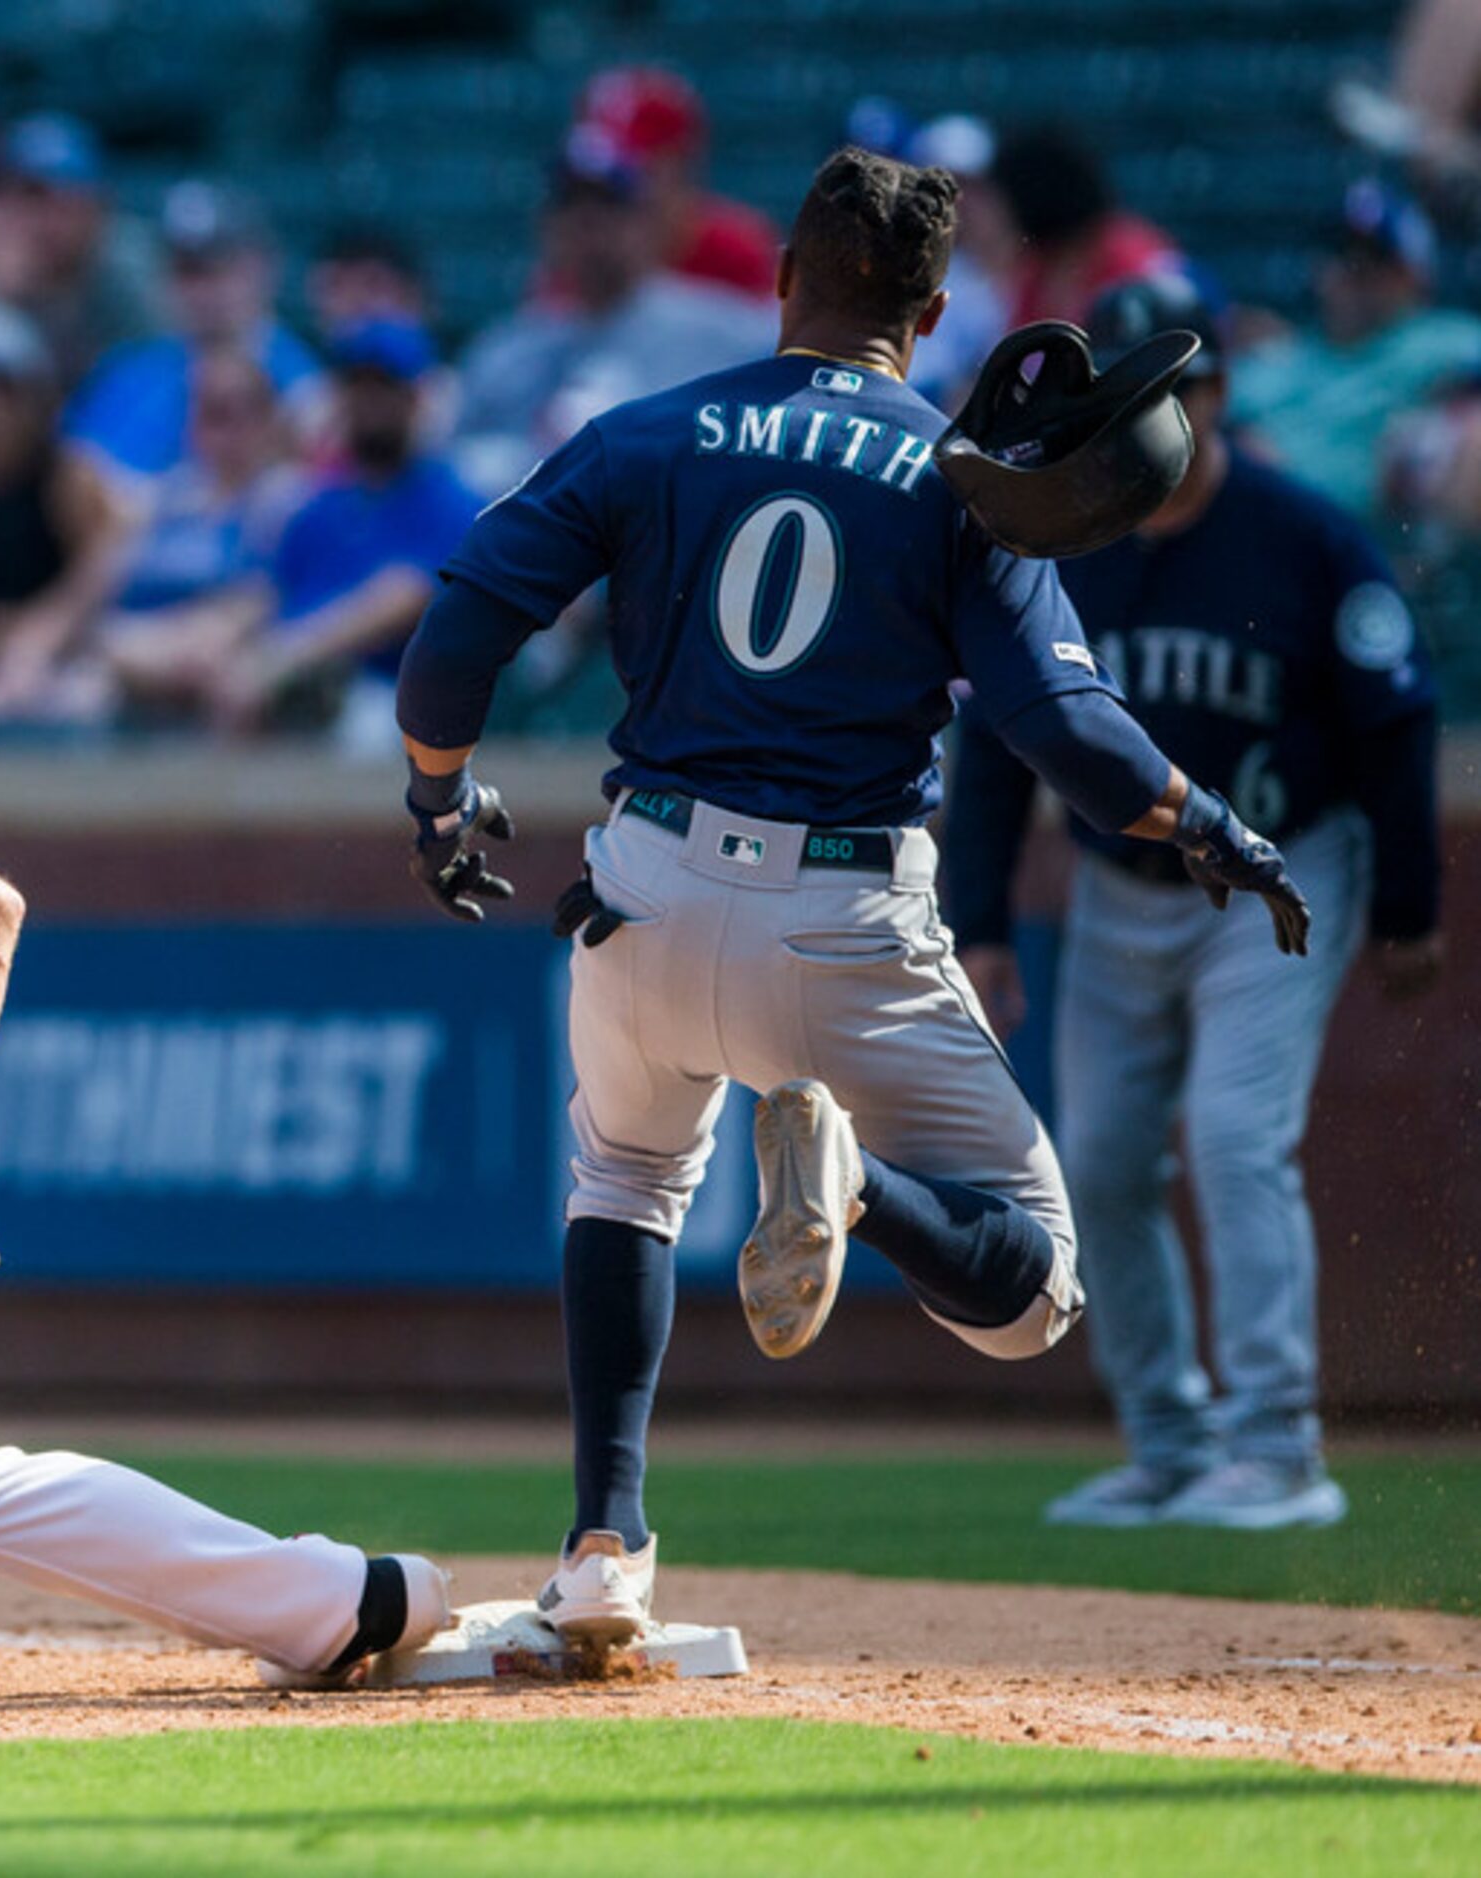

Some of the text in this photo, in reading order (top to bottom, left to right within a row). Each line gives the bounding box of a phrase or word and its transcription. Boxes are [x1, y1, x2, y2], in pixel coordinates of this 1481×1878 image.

[696, 402, 935, 498] SMITH
[710, 489, 845, 680] 0
[808, 836, 855, 860] 850
